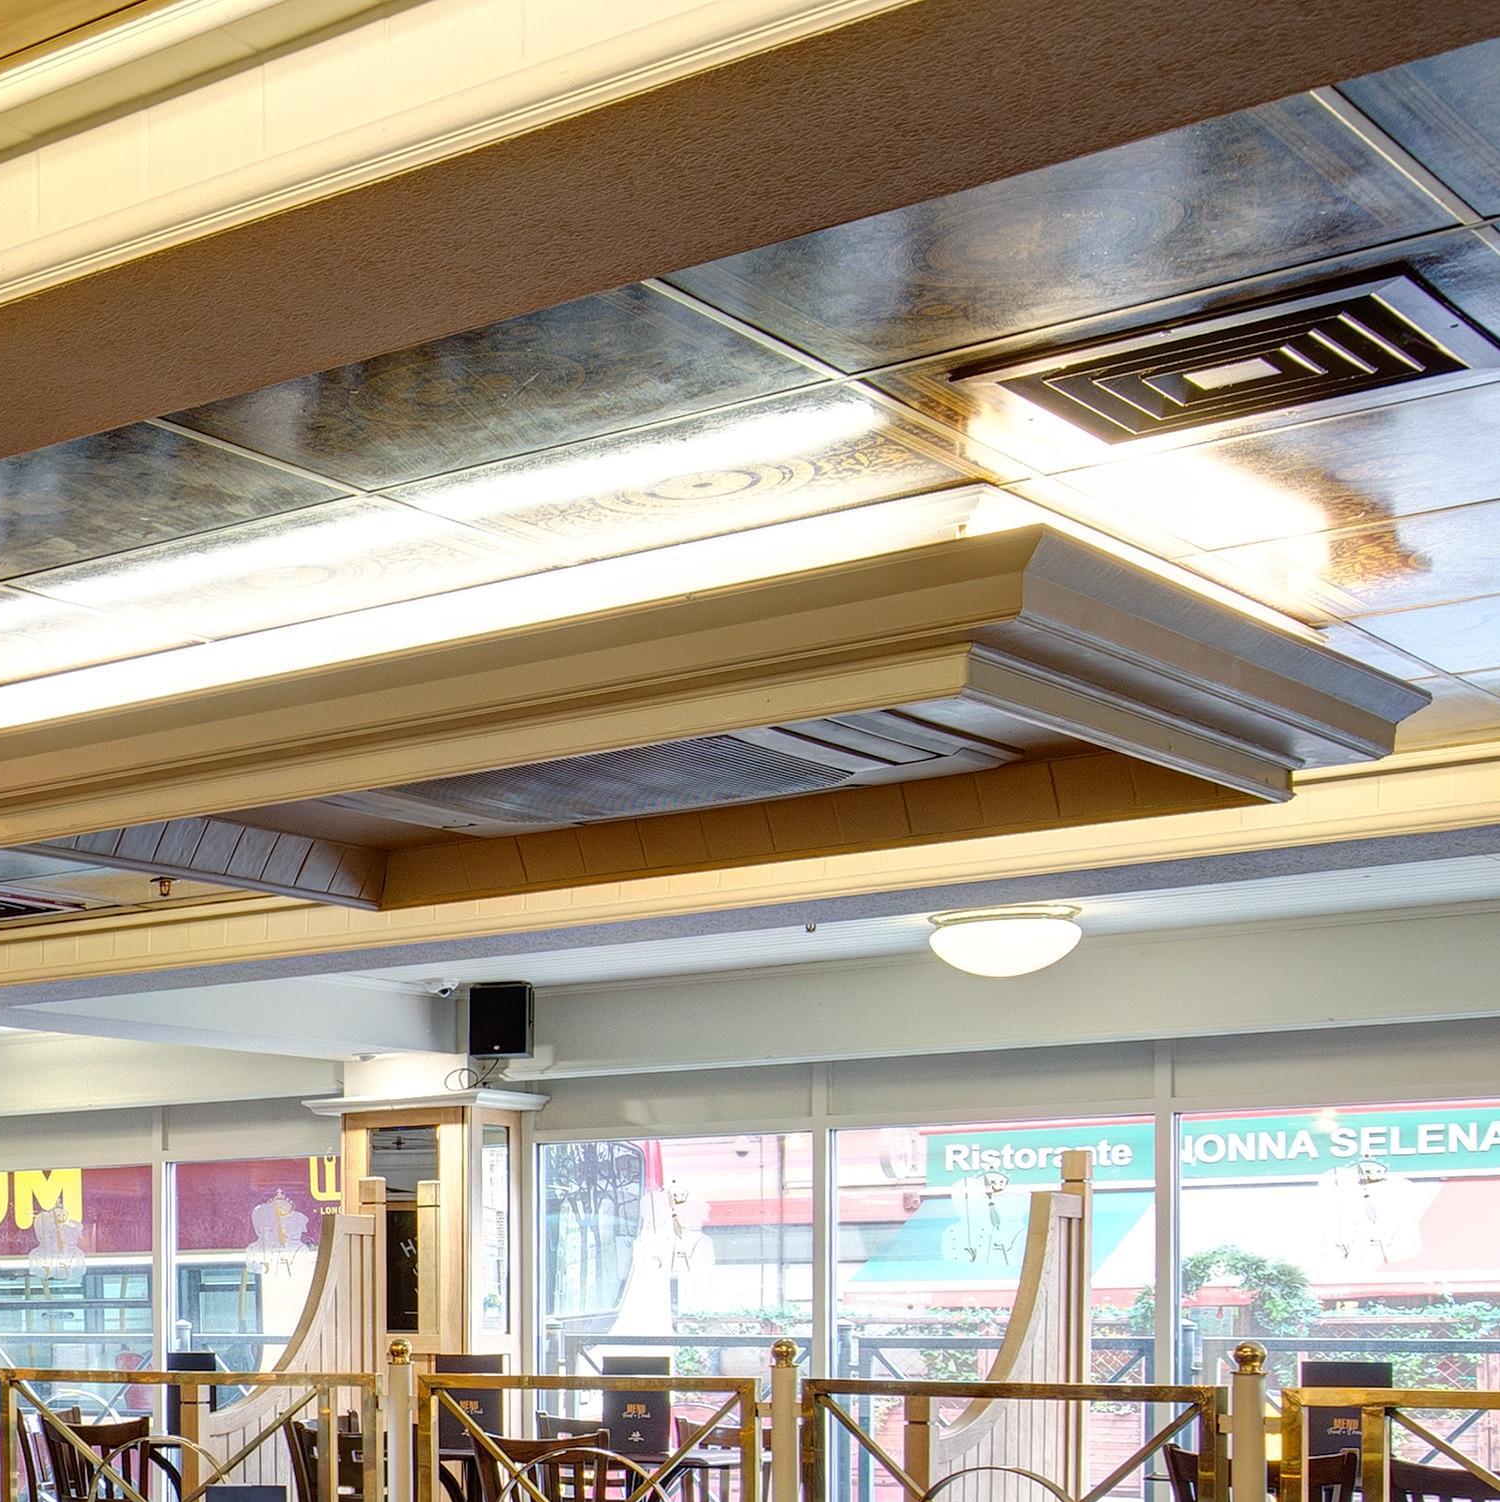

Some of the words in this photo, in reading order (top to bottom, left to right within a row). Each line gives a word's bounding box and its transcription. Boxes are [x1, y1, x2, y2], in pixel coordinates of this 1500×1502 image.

[944, 1140, 1134, 1172] Ristorate
[1329, 1120, 1500, 1158] SELENA
[320, 1207, 343, 1215] LOND
